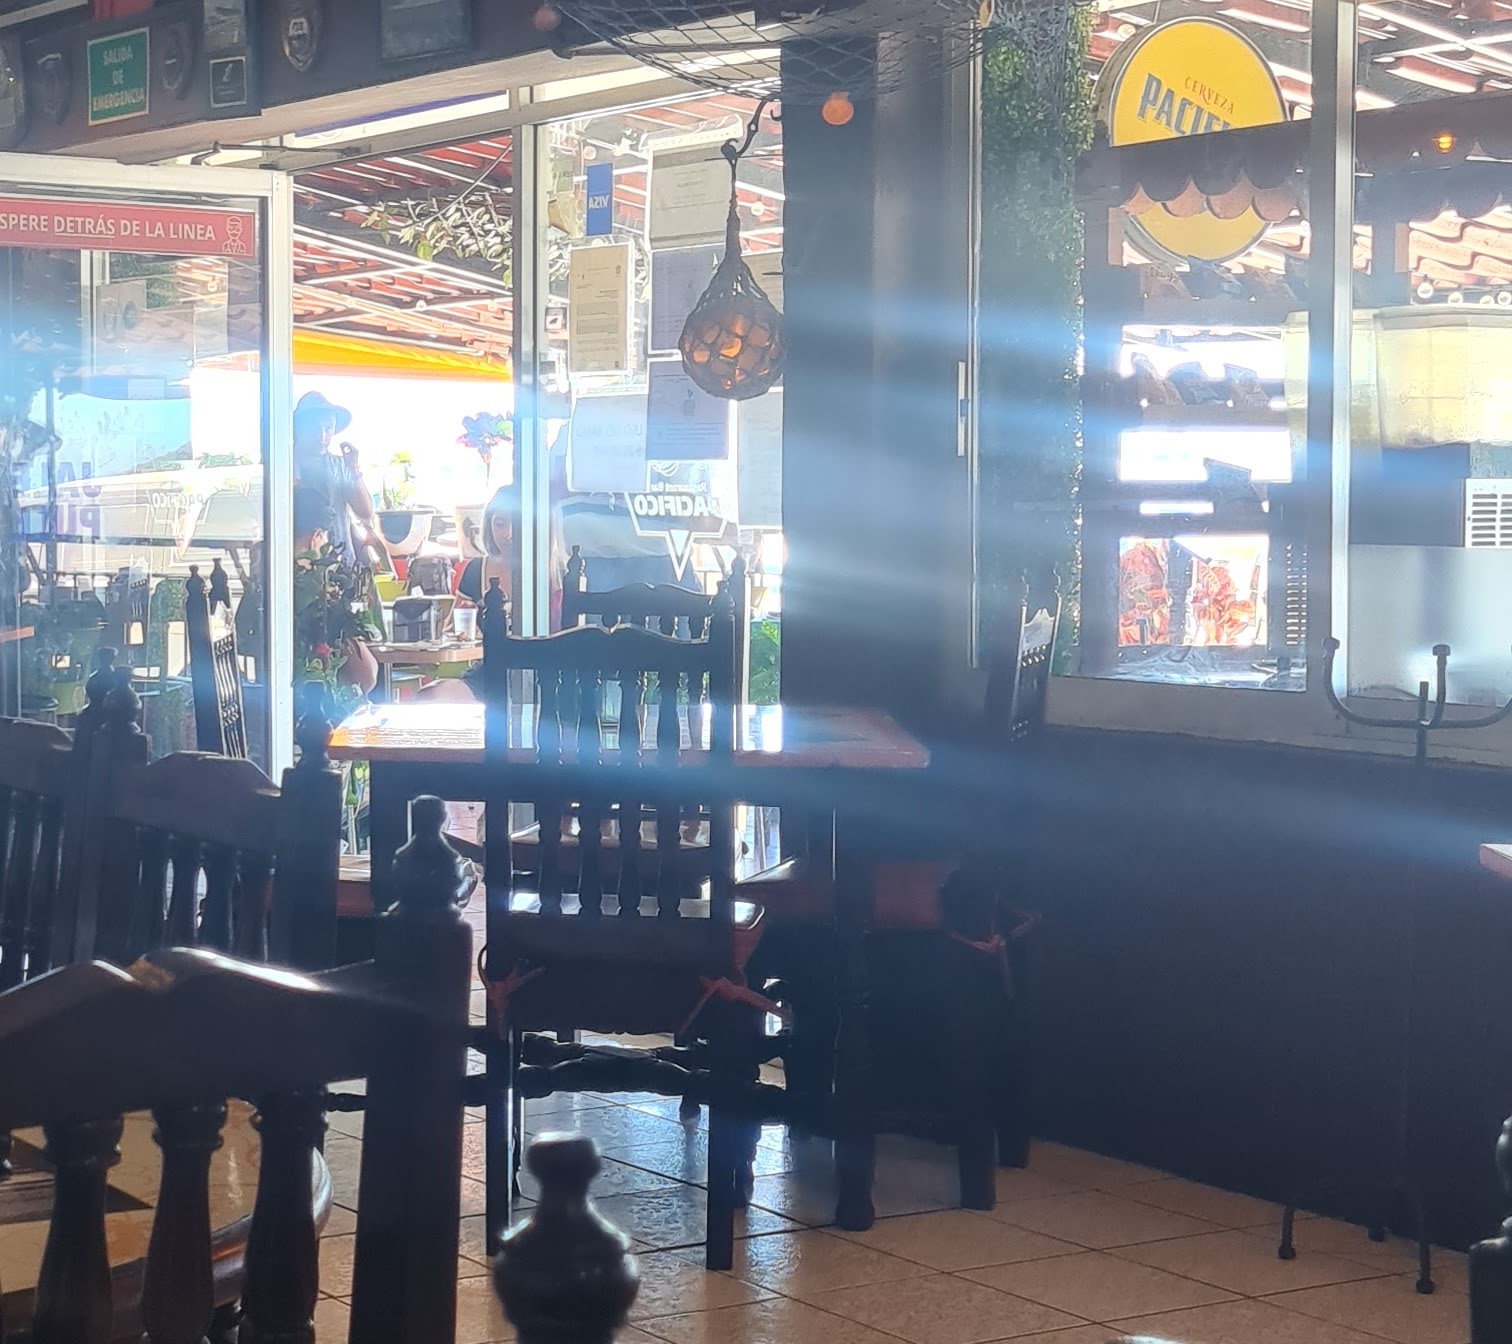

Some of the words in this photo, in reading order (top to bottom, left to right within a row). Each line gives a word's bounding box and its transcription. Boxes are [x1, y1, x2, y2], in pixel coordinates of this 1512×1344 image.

[103, 45, 133, 66] SALIDA
[113, 69, 123, 86] DE
[92, 87, 145, 111] EMERGENCIA
[1184, 76, 1234, 114] CERVEZA
[54, 214, 116, 236] DETRÁS
[120, 219, 140, 238] DE
[145, 221, 165, 239] LA
[169, 223, 216, 241] LINEA
